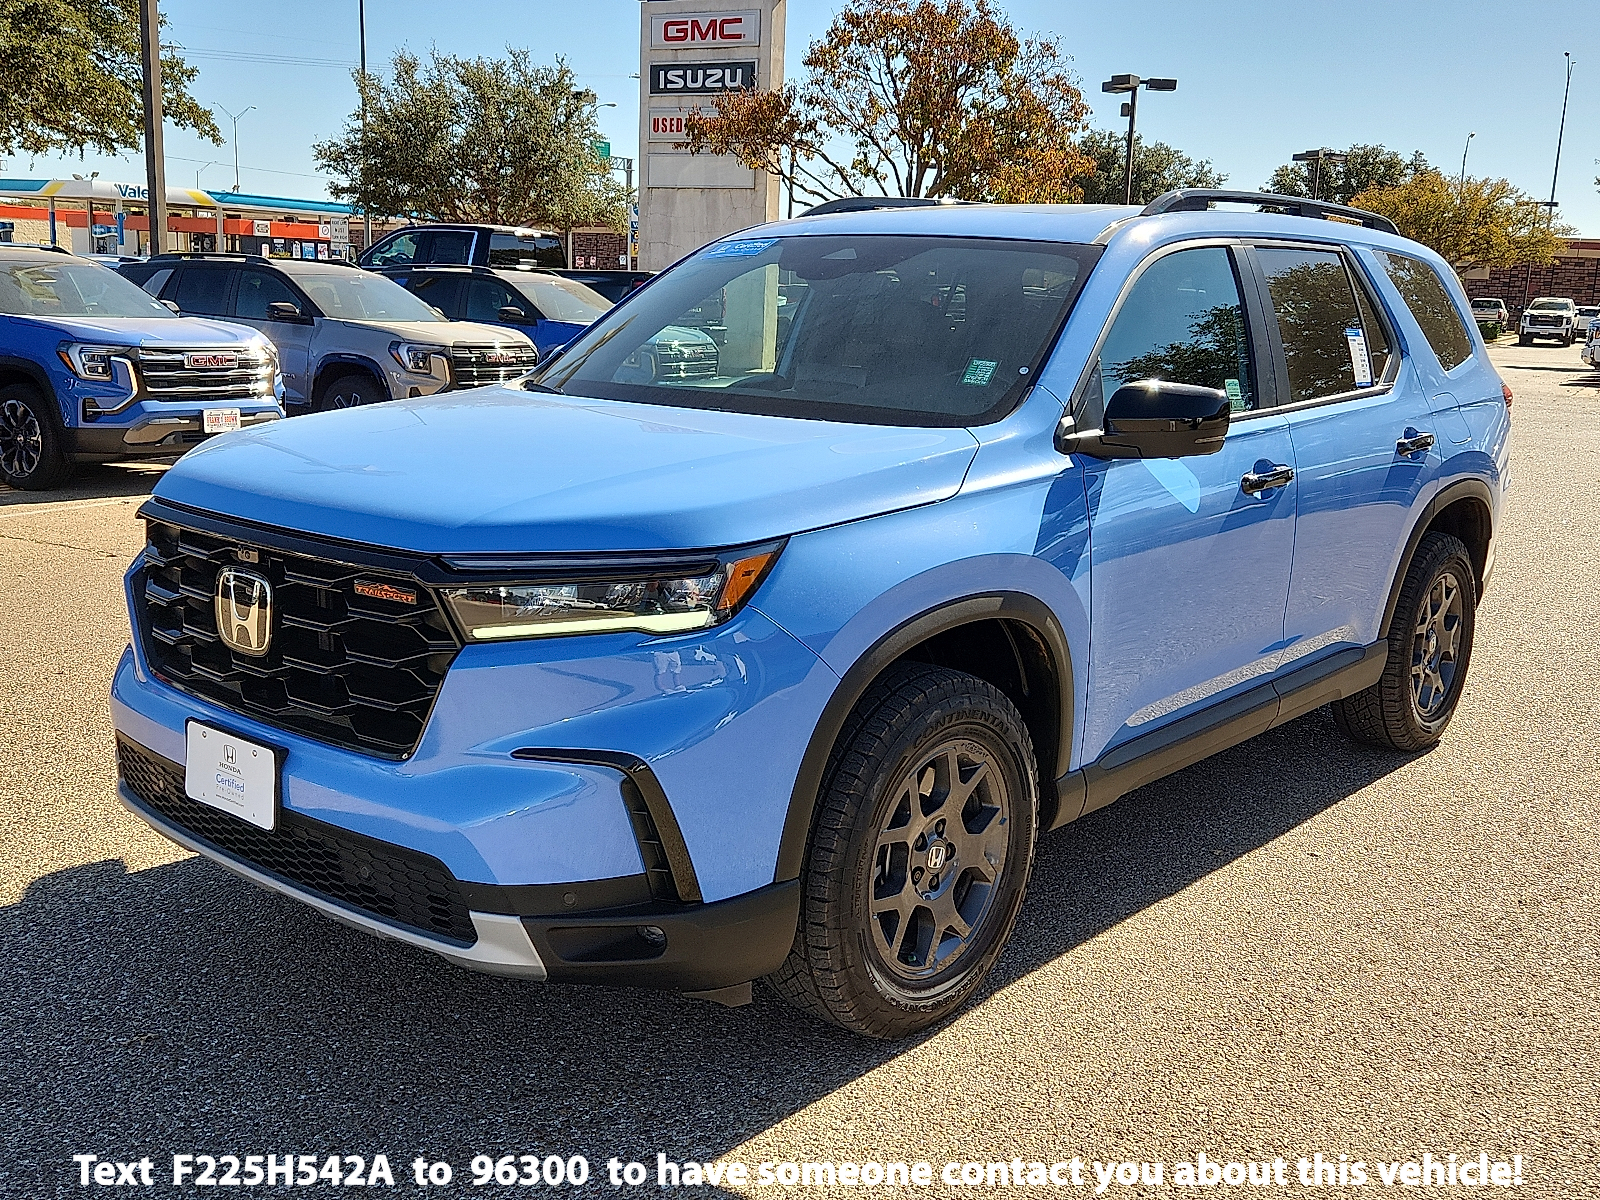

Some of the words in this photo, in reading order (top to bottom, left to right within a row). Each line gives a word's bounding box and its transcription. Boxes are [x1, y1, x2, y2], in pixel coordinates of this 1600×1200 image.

[663, 18, 744, 41] GMC
[659, 68, 743, 89] ISUZU
[652, 117, 683, 133] USED
[118, 184, 149, 198] Vale
[190, 355, 238, 367] GMC
[355, 585, 415, 603] TRAILSPORT
[219, 761, 242, 775] HONDA
[215, 773, 245, 793] Certified
